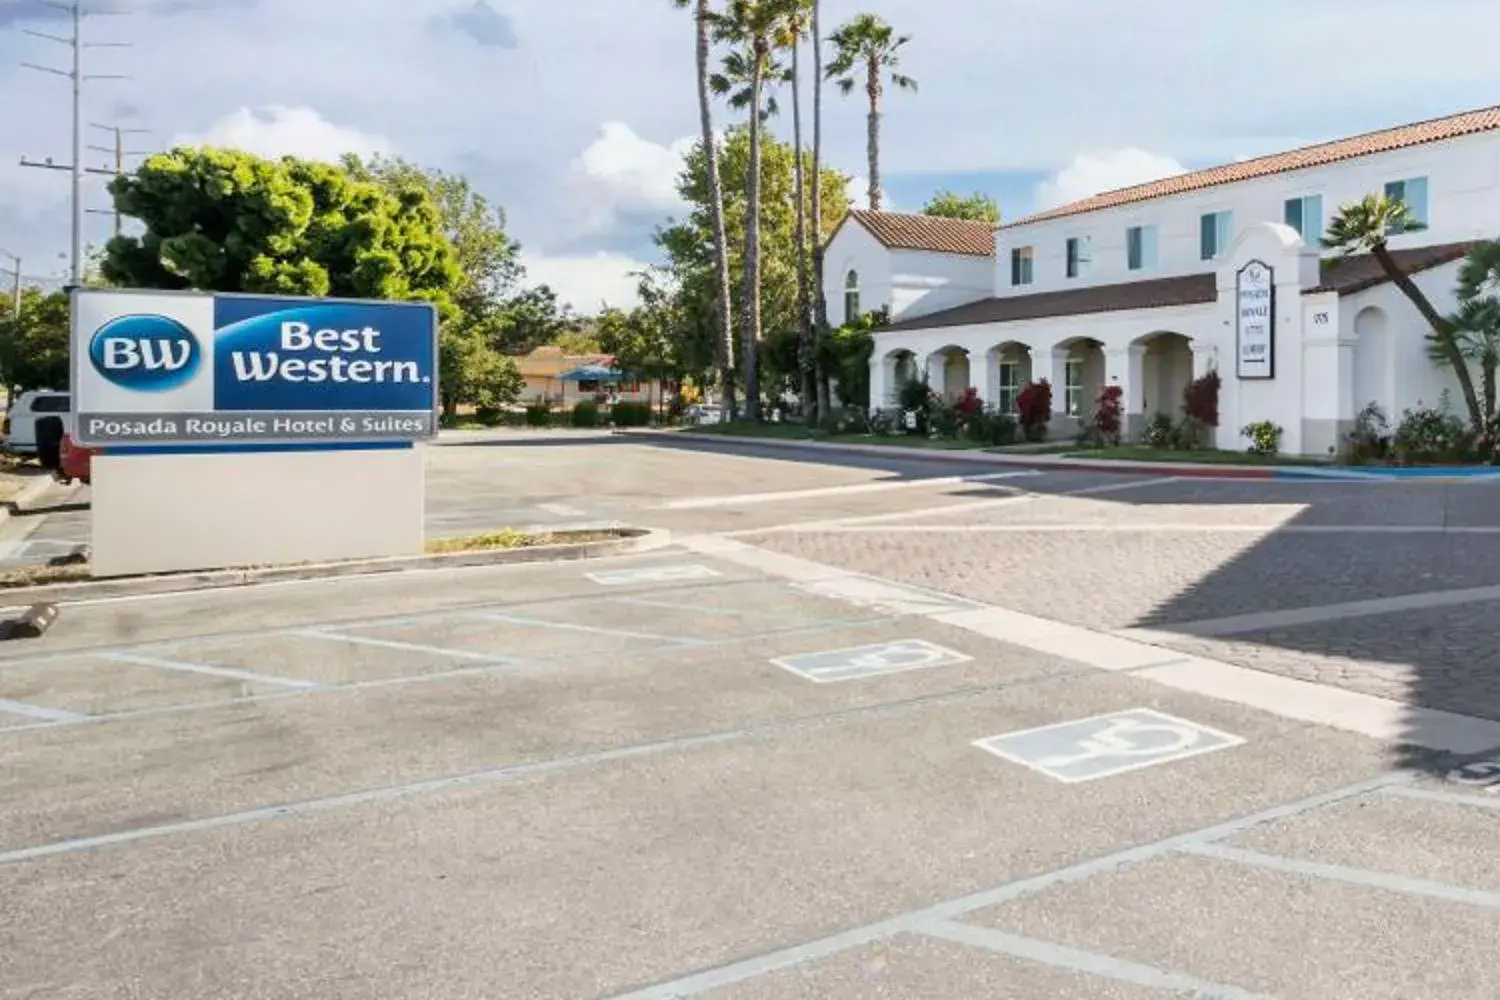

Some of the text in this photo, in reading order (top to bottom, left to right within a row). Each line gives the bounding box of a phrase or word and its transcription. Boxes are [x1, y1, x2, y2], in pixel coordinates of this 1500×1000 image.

[281, 321, 381, 353] Best
[103, 337, 191, 371] BW
[89, 415, 423, 437] Posada Royale Hotel & Suites
